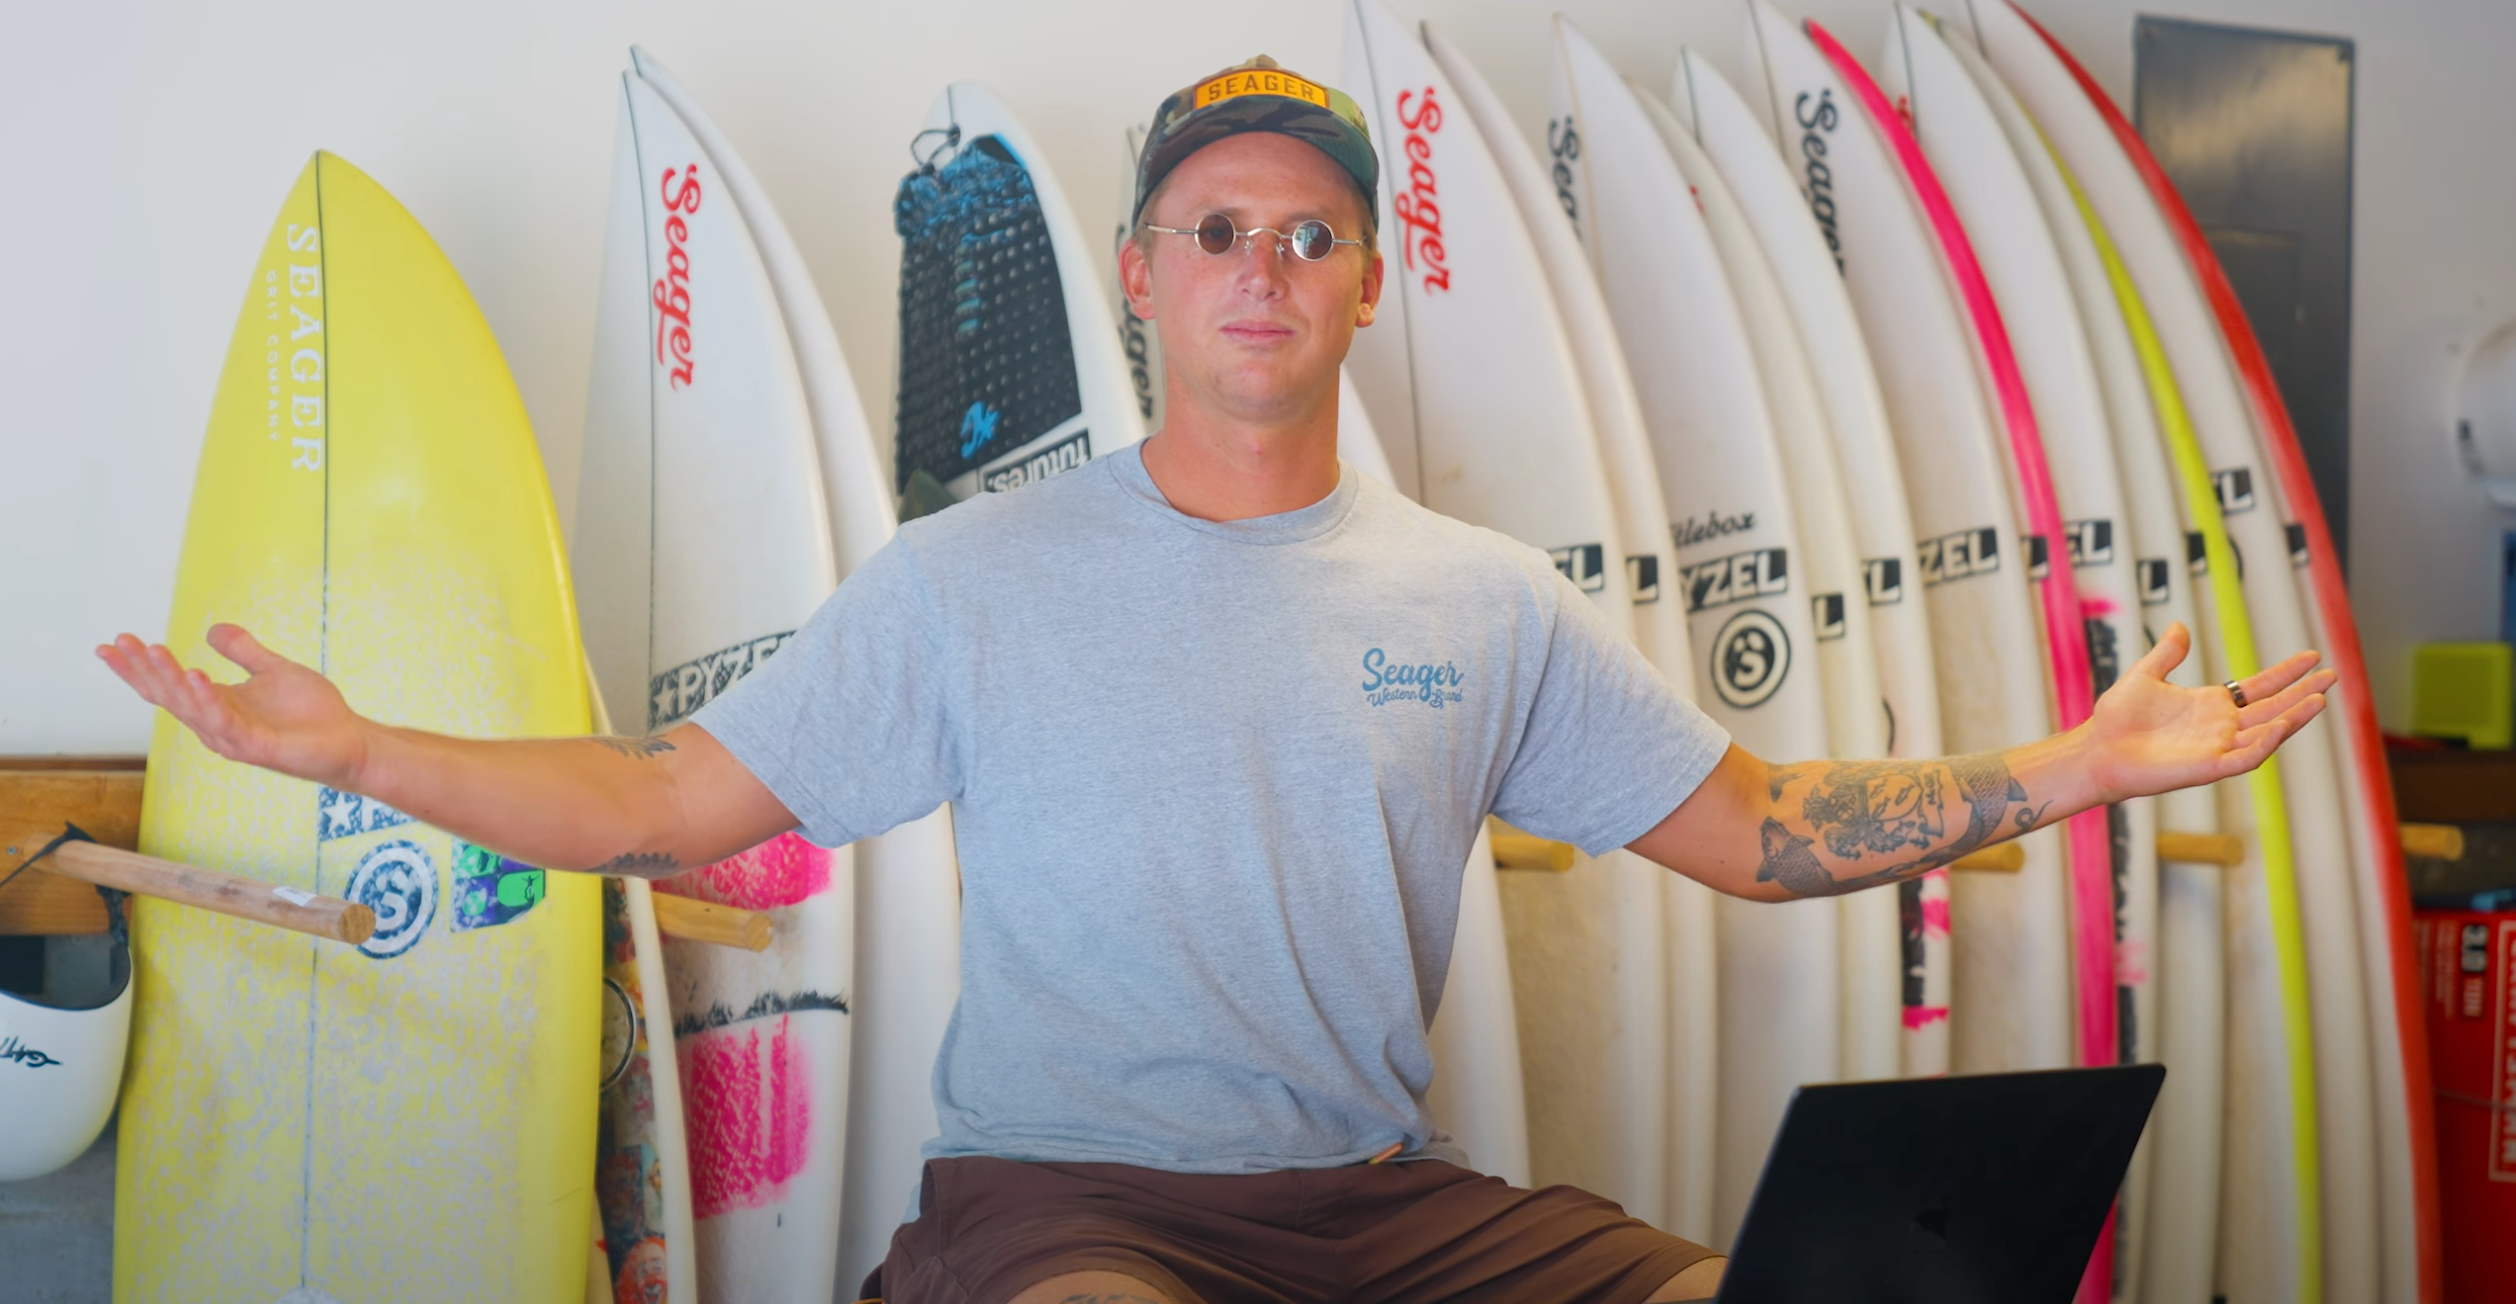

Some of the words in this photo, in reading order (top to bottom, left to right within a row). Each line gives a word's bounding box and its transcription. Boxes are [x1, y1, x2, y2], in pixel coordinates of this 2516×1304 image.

[1208, 74, 1314, 101] SEAGER
[1395, 86, 1451, 295] Seager
[266, 269, 278, 321] GRIT
[652, 163, 702, 392] Seager
[286, 223, 323, 472] SEAGER
[266, 334, 279, 441] COMPANY
[1671, 510, 1755, 547] tlebox
[1362, 647, 1465, 702] Seager
[1366, 687, 1418, 707] Western
